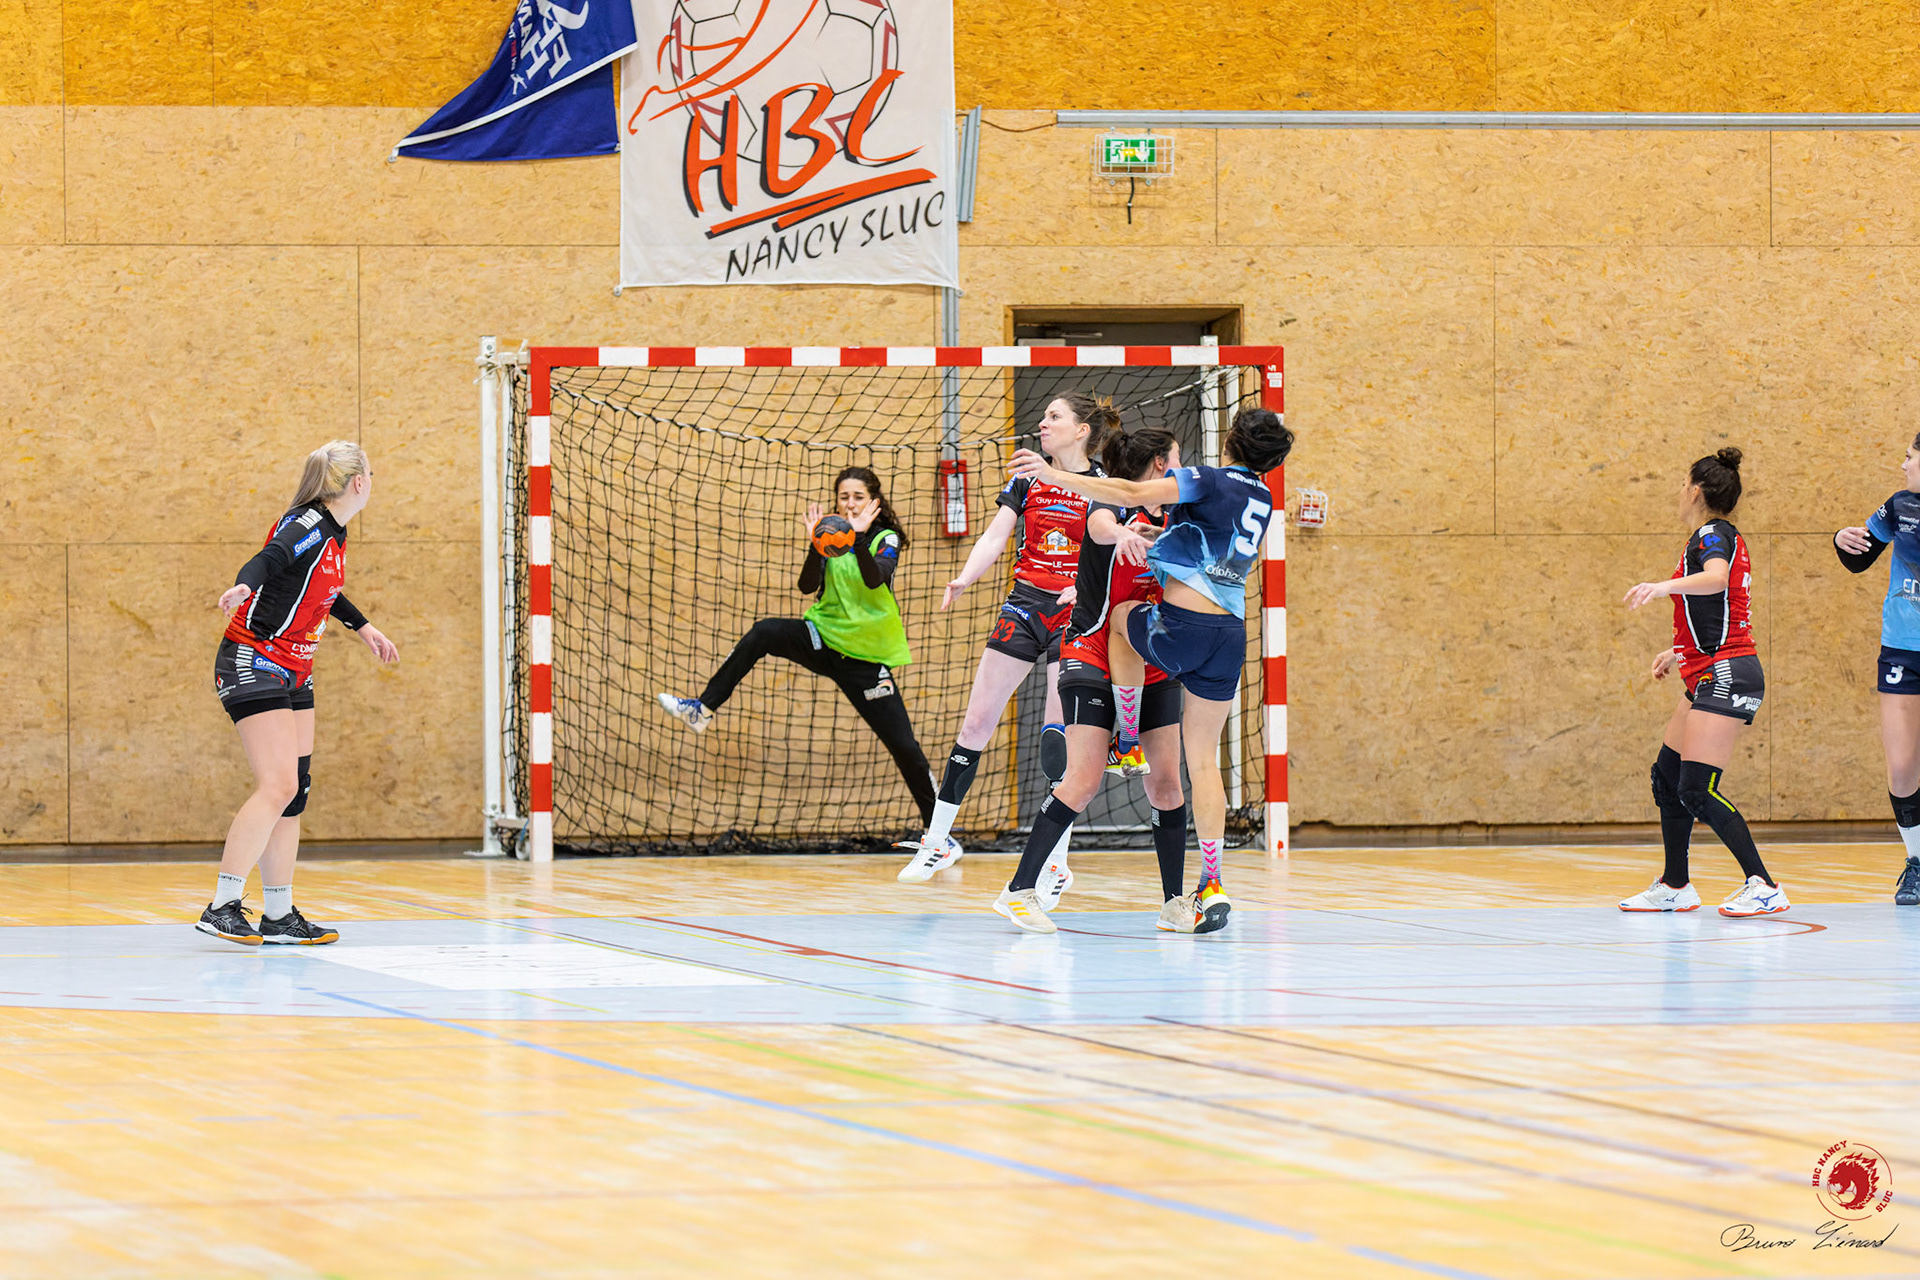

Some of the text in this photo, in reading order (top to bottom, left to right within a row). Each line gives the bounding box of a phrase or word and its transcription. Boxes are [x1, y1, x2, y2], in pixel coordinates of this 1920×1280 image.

[682, 69, 924, 217] HBC
[725, 190, 945, 282] NANCY SLUC
[1235, 497, 1271, 557] 5
[991, 618, 1016, 642] 23
[1885, 665, 1904, 686] 3
